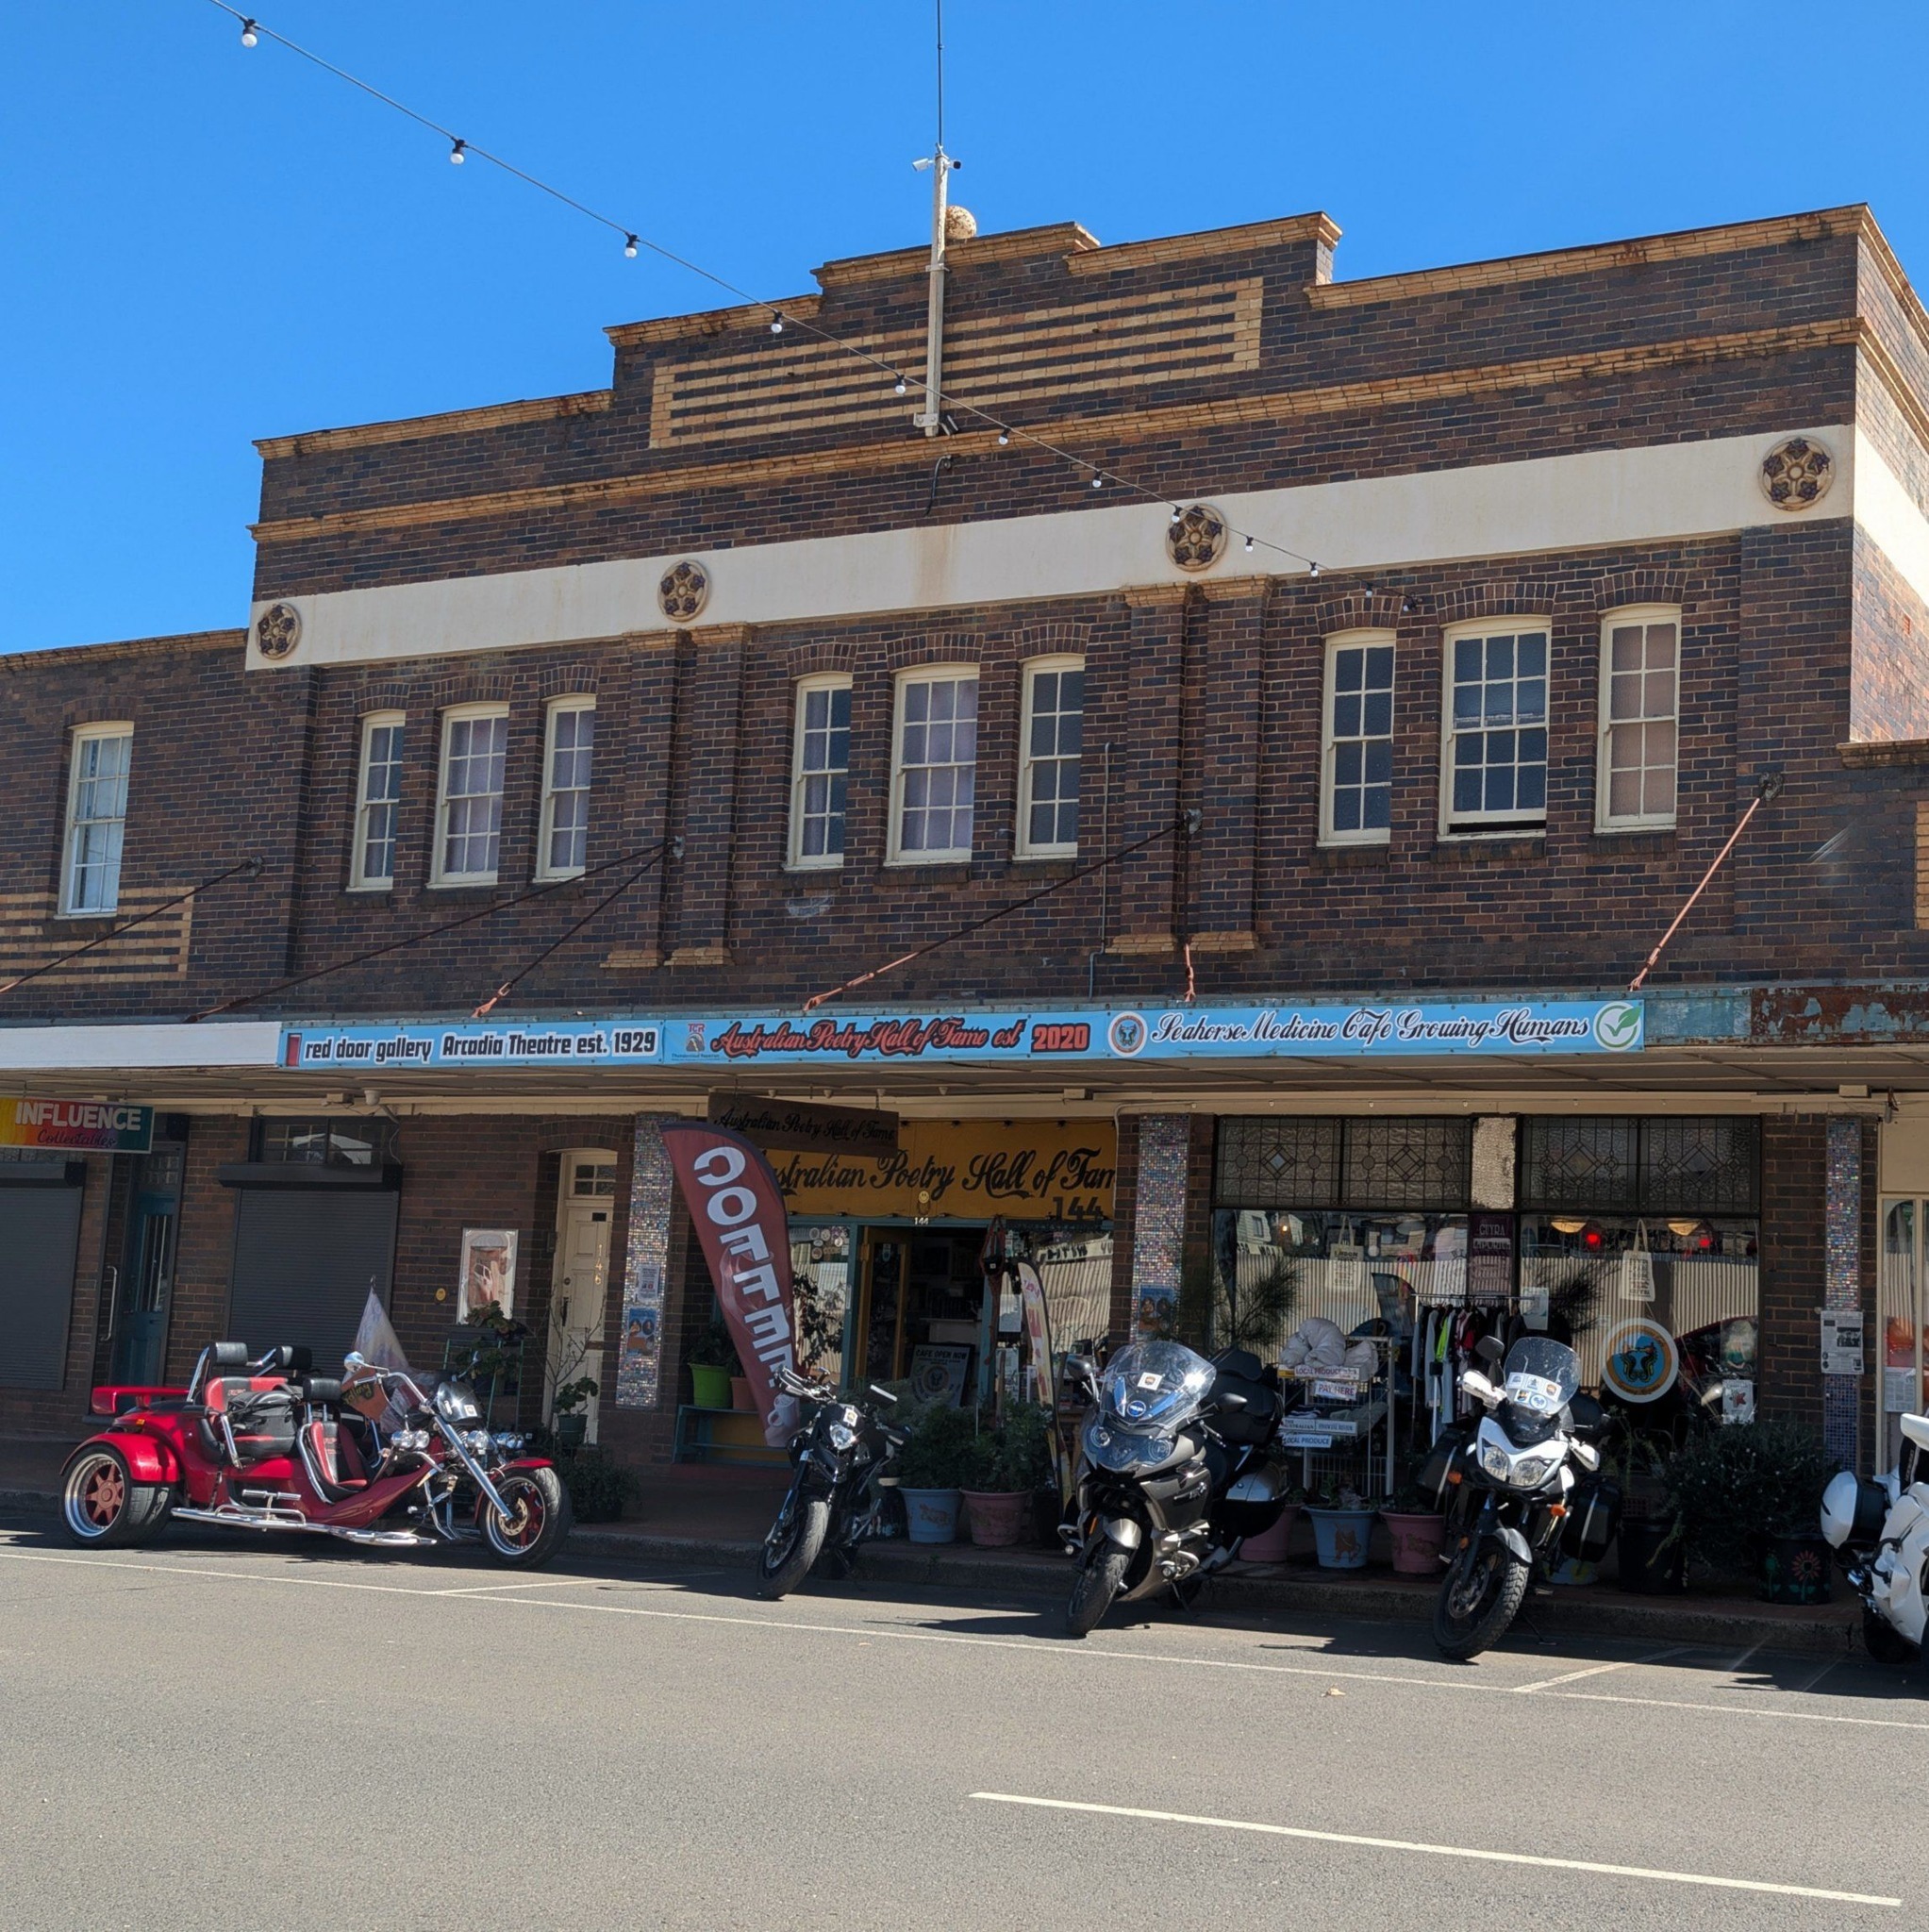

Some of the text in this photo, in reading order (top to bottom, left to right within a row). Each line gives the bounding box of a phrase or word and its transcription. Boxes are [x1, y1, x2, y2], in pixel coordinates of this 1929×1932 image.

[710, 1018, 1090, 1058] Australian Poetry Hall of Fame est 2020
[1152, 1012, 1243, 1042] Seahorse
[1242, 1011, 1337, 1042] Medicine
[1397, 1008, 1489, 1047] Growing
[1488, 1007, 1589, 1045] Humans
[305, 1031, 656, 1062] red door gallery Arcadia Theatre est. 1929
[15, 1102, 141, 1131] INFLUENCE
[714, 1107, 895, 1141] Australian Poetry Hall of Fame
[37, 1130, 117, 1148] Collectables
[762, 1149, 866, 1196] stralian
[870, 1149, 956, 1201] Poetry
[962, 1149, 1037, 1199] Hall
[1032, 1150, 1068, 1198] of
[915, 1217, 929, 1225] 144
[1053, 1196, 1104, 1224] 144
[1479, 1224, 1505, 1236] GUYRA
[1295, 1367, 1314, 1375] LOCAL
[1318, 1383, 1355, 1396] PAY HERE
[1283, 1436, 1331, 1445] LOCAL PRODUCE
